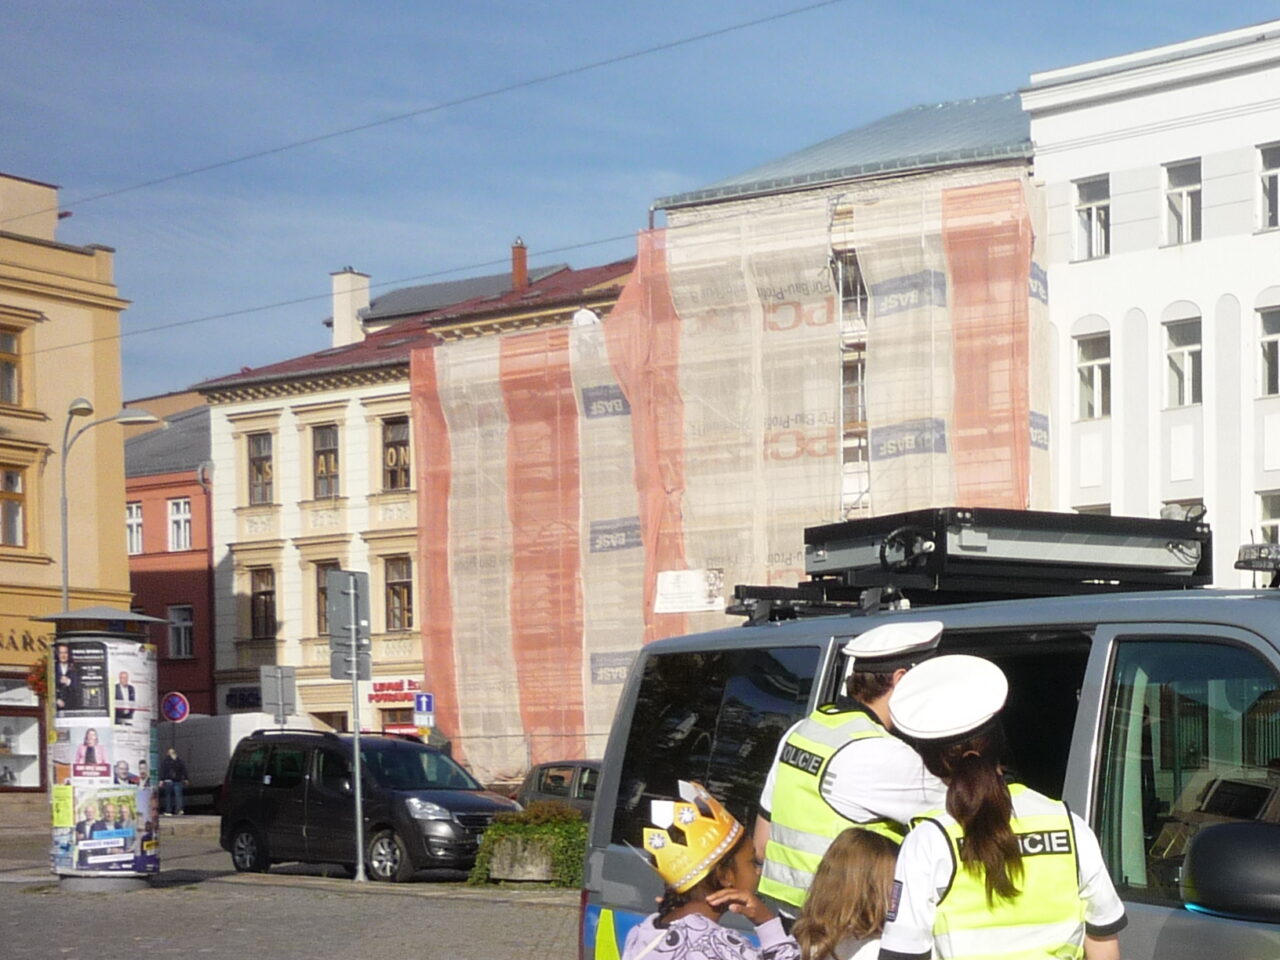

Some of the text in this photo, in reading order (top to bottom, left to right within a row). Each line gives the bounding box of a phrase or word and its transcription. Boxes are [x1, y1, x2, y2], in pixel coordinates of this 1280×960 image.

[879, 289, 919, 312] BASF
[589, 398, 624, 416] BASF
[879, 435, 916, 456] BASF
[783, 745, 821, 774] OLICIE
[1018, 832, 1069, 854] ICIE
